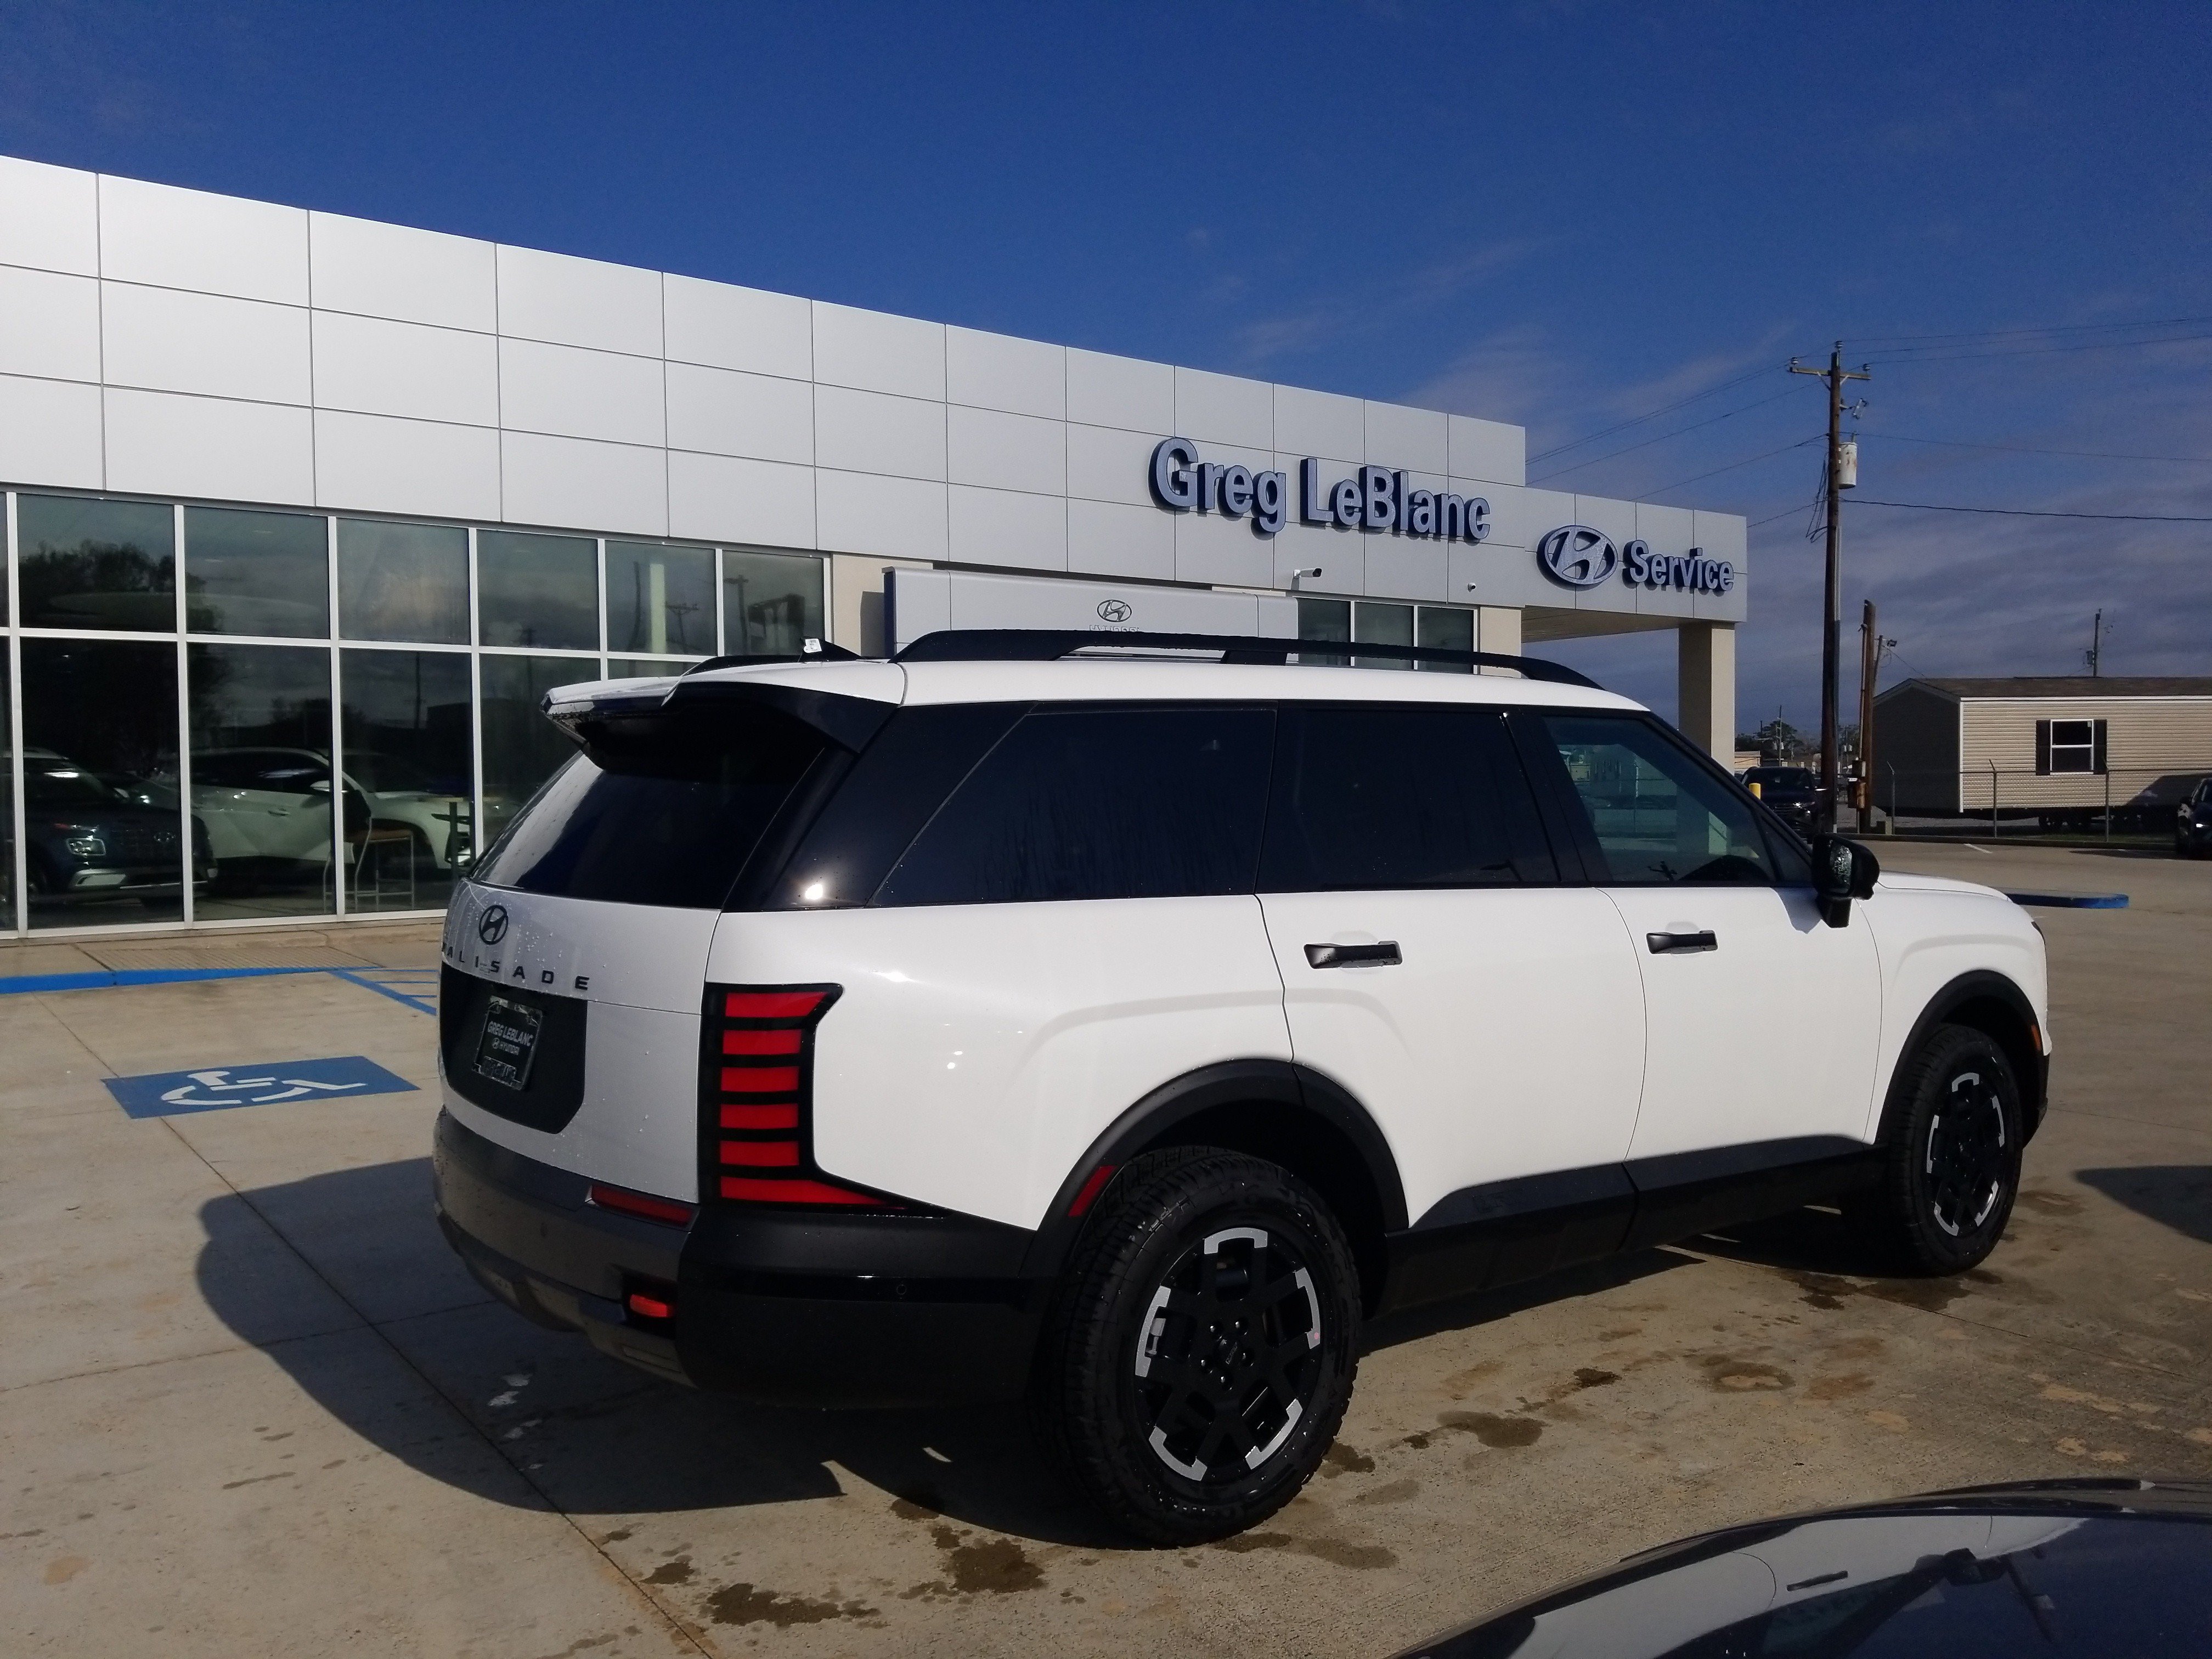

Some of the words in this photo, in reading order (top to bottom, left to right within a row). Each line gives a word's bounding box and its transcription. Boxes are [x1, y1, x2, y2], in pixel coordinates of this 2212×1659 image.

[1149, 437, 1286, 533] Greg
[1300, 457, 1491, 540] LeBlanc
[1623, 539, 1734, 591] Service
[488, 1021, 504, 1036] GREG
[503, 1026, 534, 1047] LEBLANC
